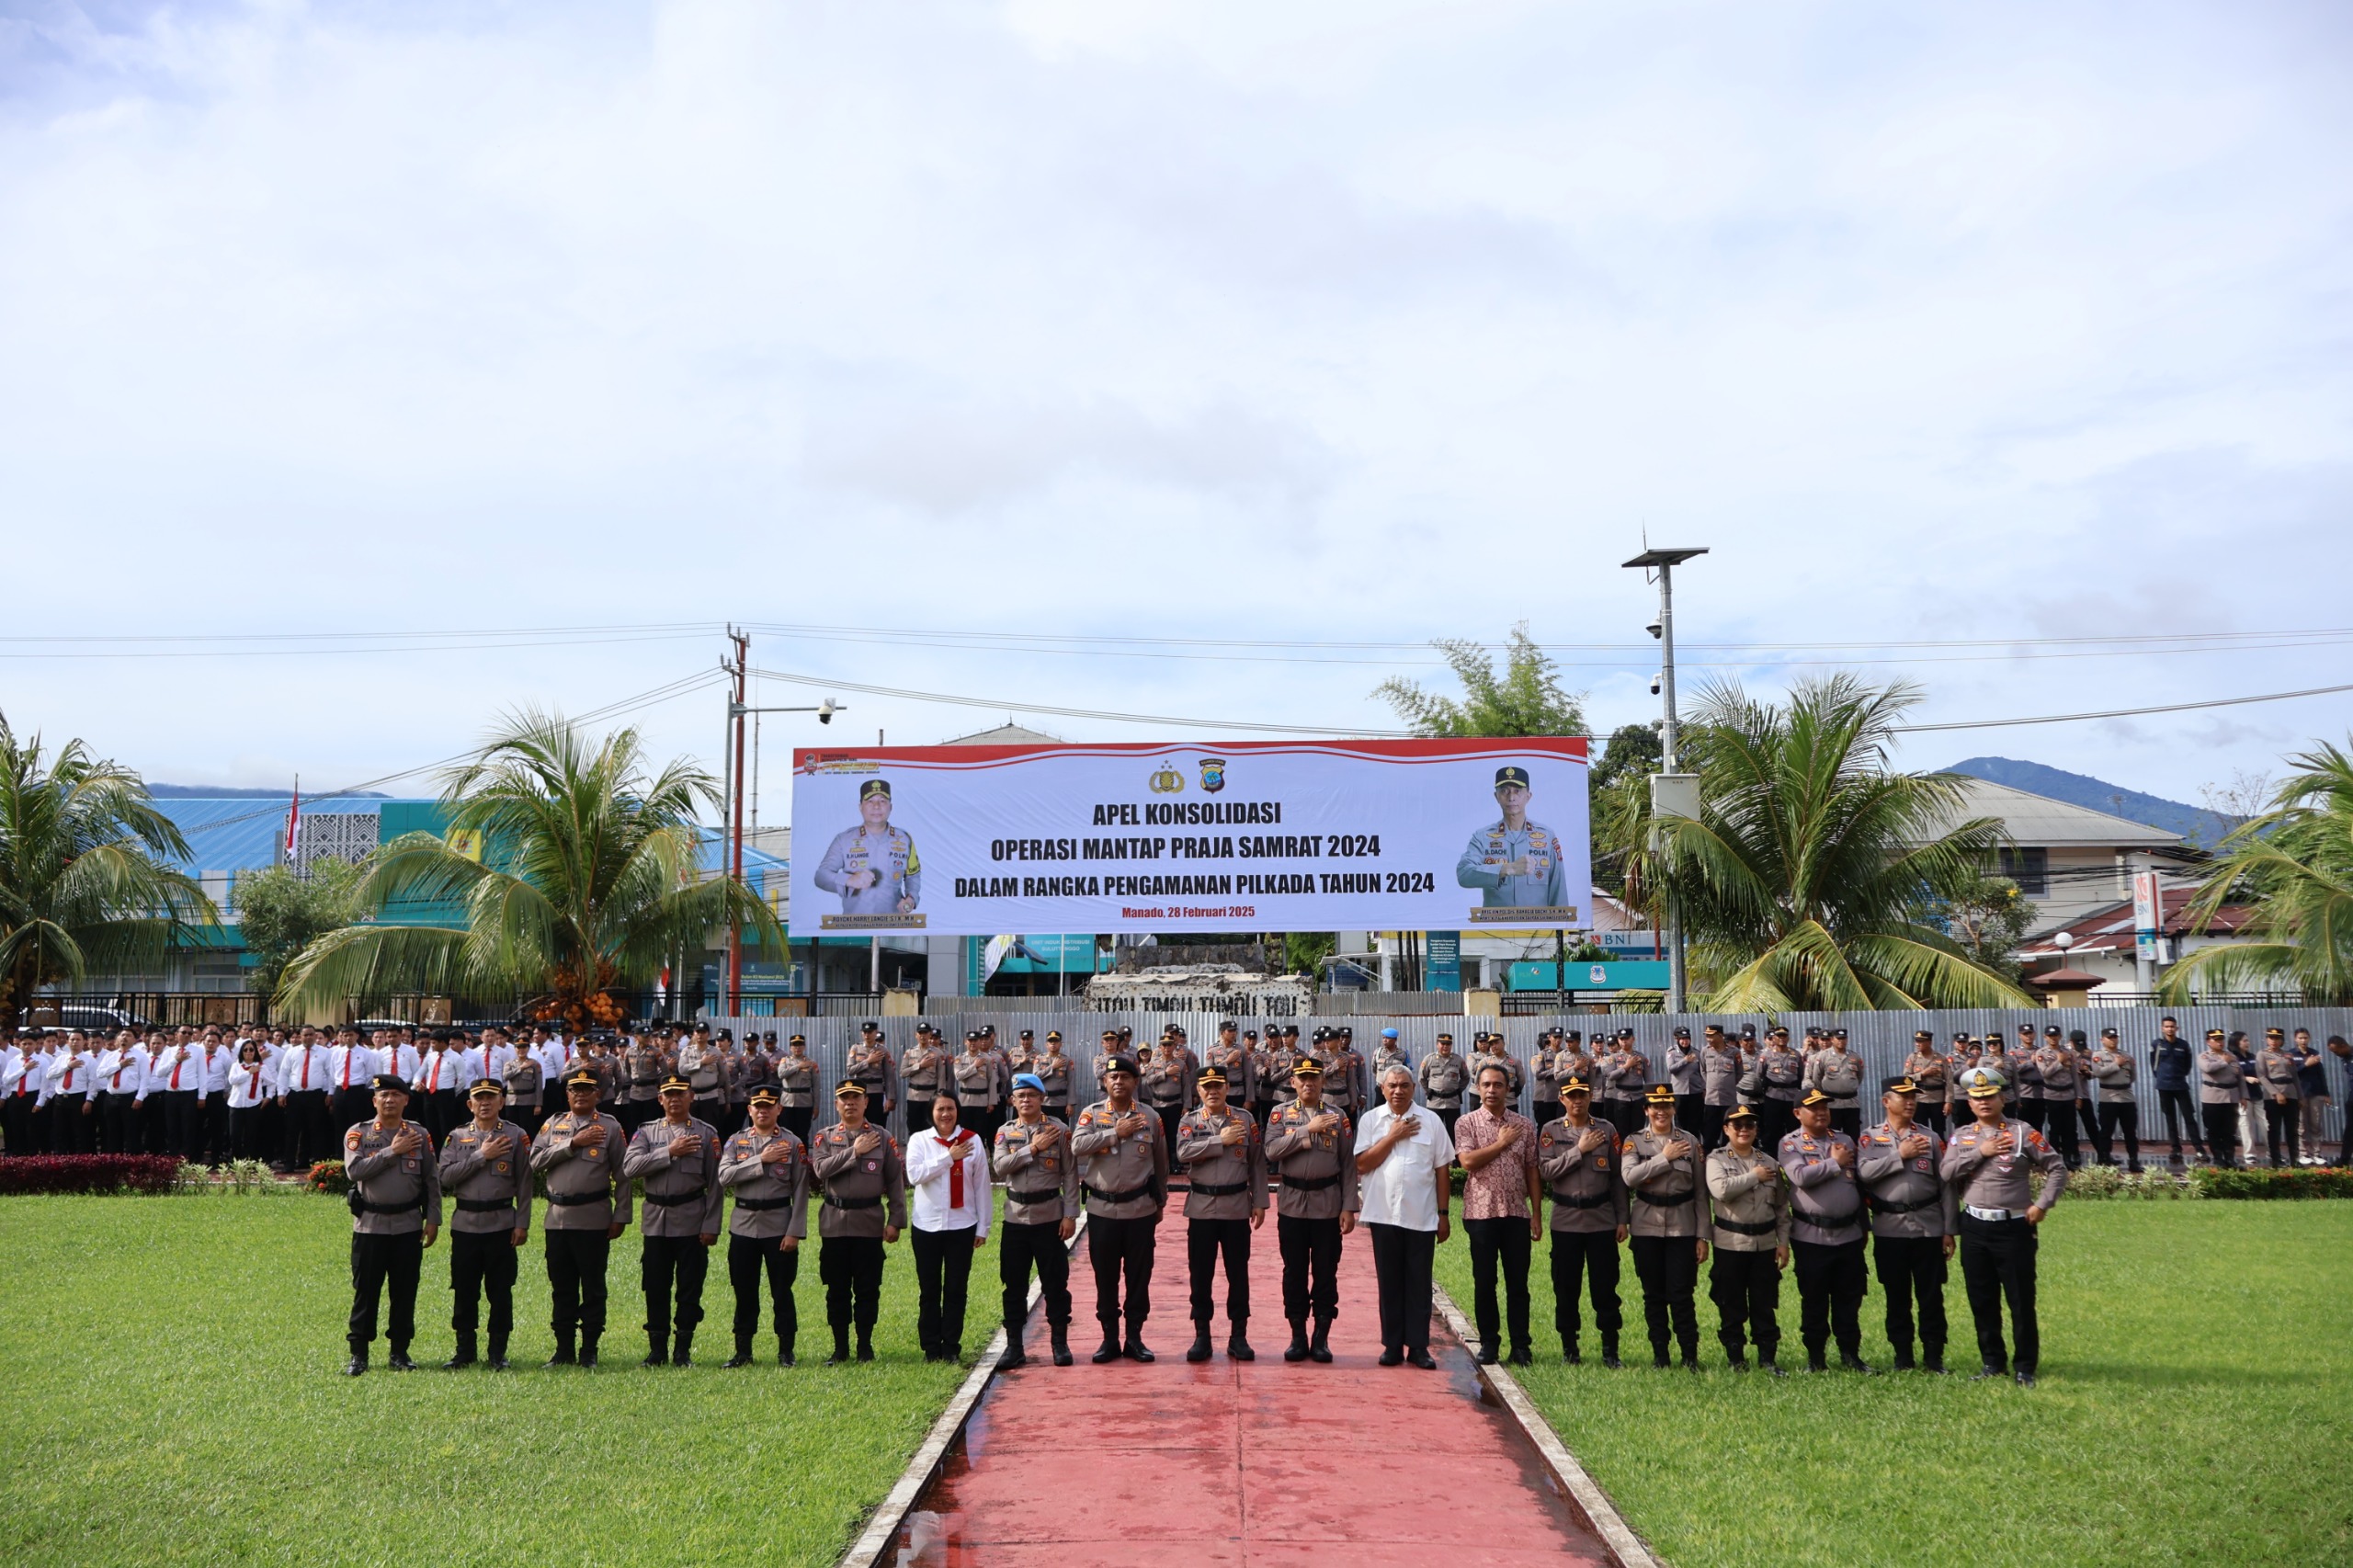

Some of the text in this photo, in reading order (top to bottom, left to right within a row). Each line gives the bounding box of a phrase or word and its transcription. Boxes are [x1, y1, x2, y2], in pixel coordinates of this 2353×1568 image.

[1093, 802, 1281, 825] APEL KONSOLIDASI
[991, 835, 1381, 861] OPERASI MANTAP PRAJA SAMRAT 2024
[889, 852, 908, 860] POLRI
[955, 872, 1436, 898] DALAM RANGKA PENGAMANAN PILKADA TAHUN 2024
[1121, 905, 1255, 920] Manado, 28 Februari 2025
[2137, 903, 2150, 916] BNI
[1605, 934, 1631, 945] BNI
